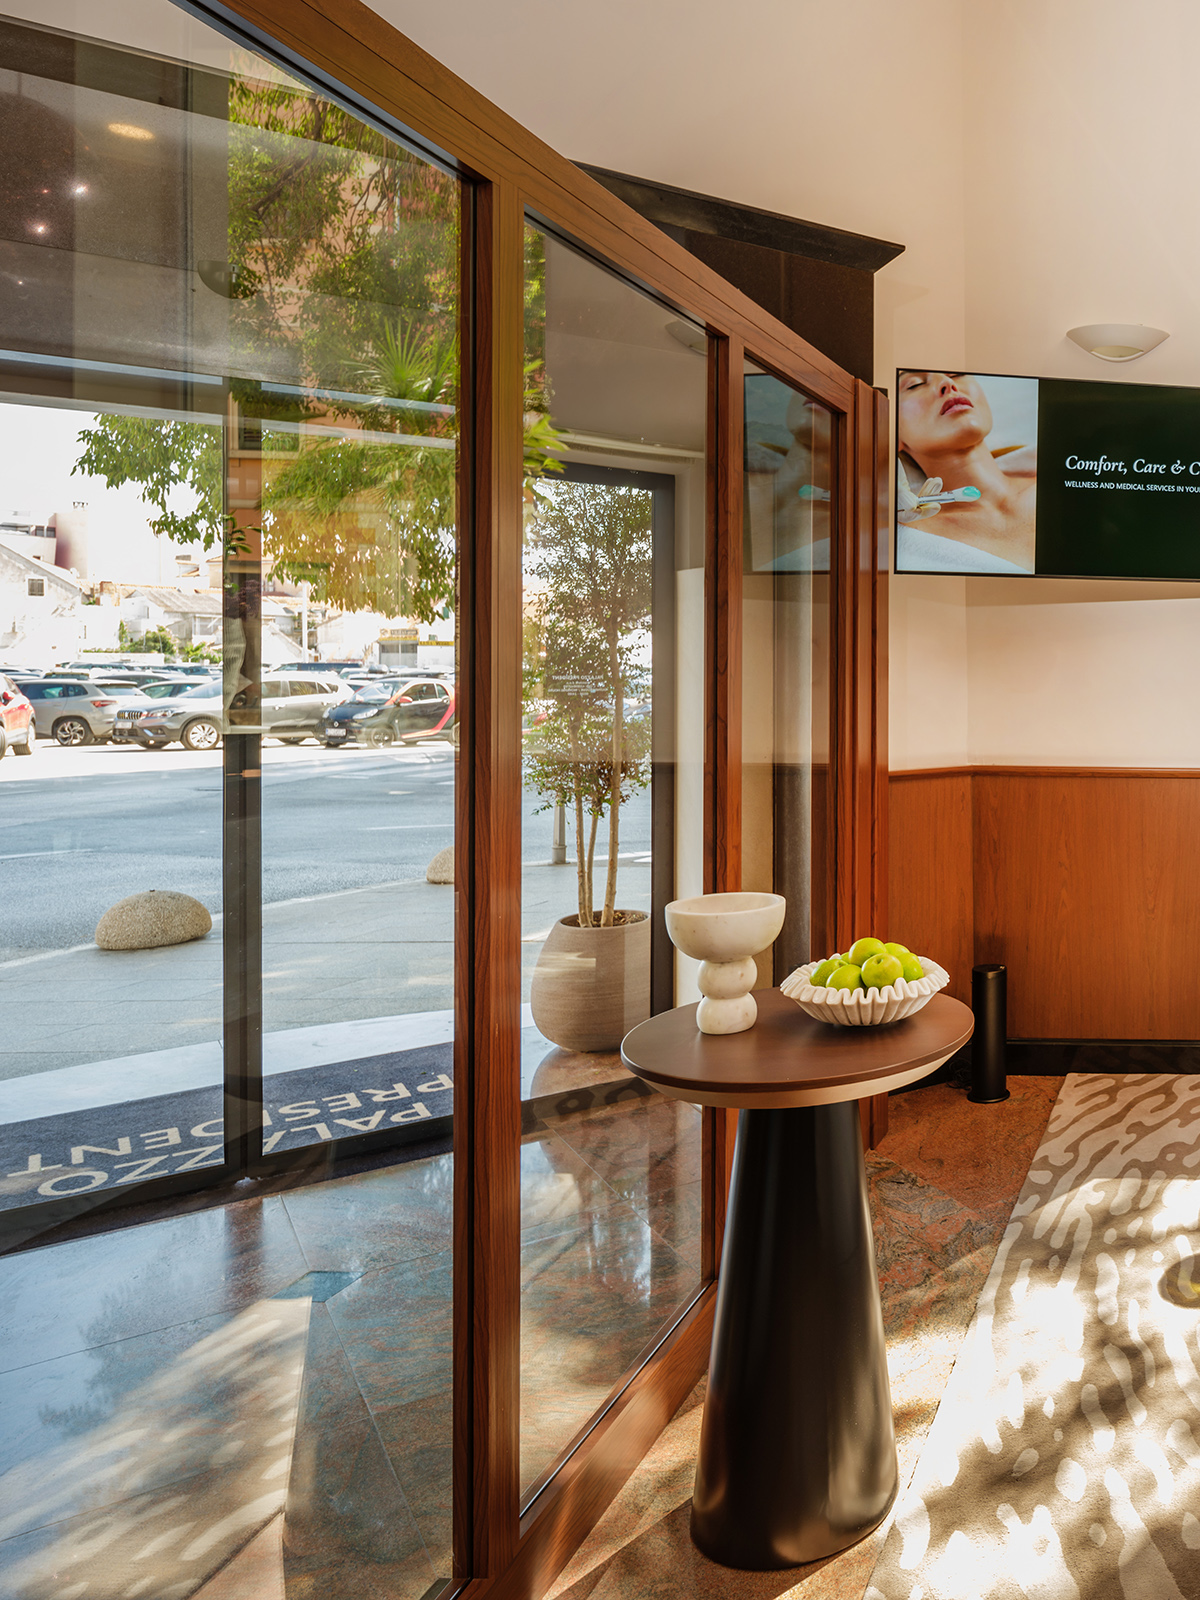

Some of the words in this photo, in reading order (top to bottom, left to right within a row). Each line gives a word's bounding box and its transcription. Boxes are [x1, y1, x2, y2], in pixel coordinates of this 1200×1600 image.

[1065, 455, 1128, 476] Comfort,
[1132, 458, 1167, 474] Care
[1170, 459, 1186, 475] &
[1064, 480, 1099, 489] WELLNESS
[1099, 482, 1115, 490] AND
[1115, 482, 1146, 491] MEDICAL
[1146, 484, 1176, 492] SERVICES
[1176, 485, 1184, 493] IN
